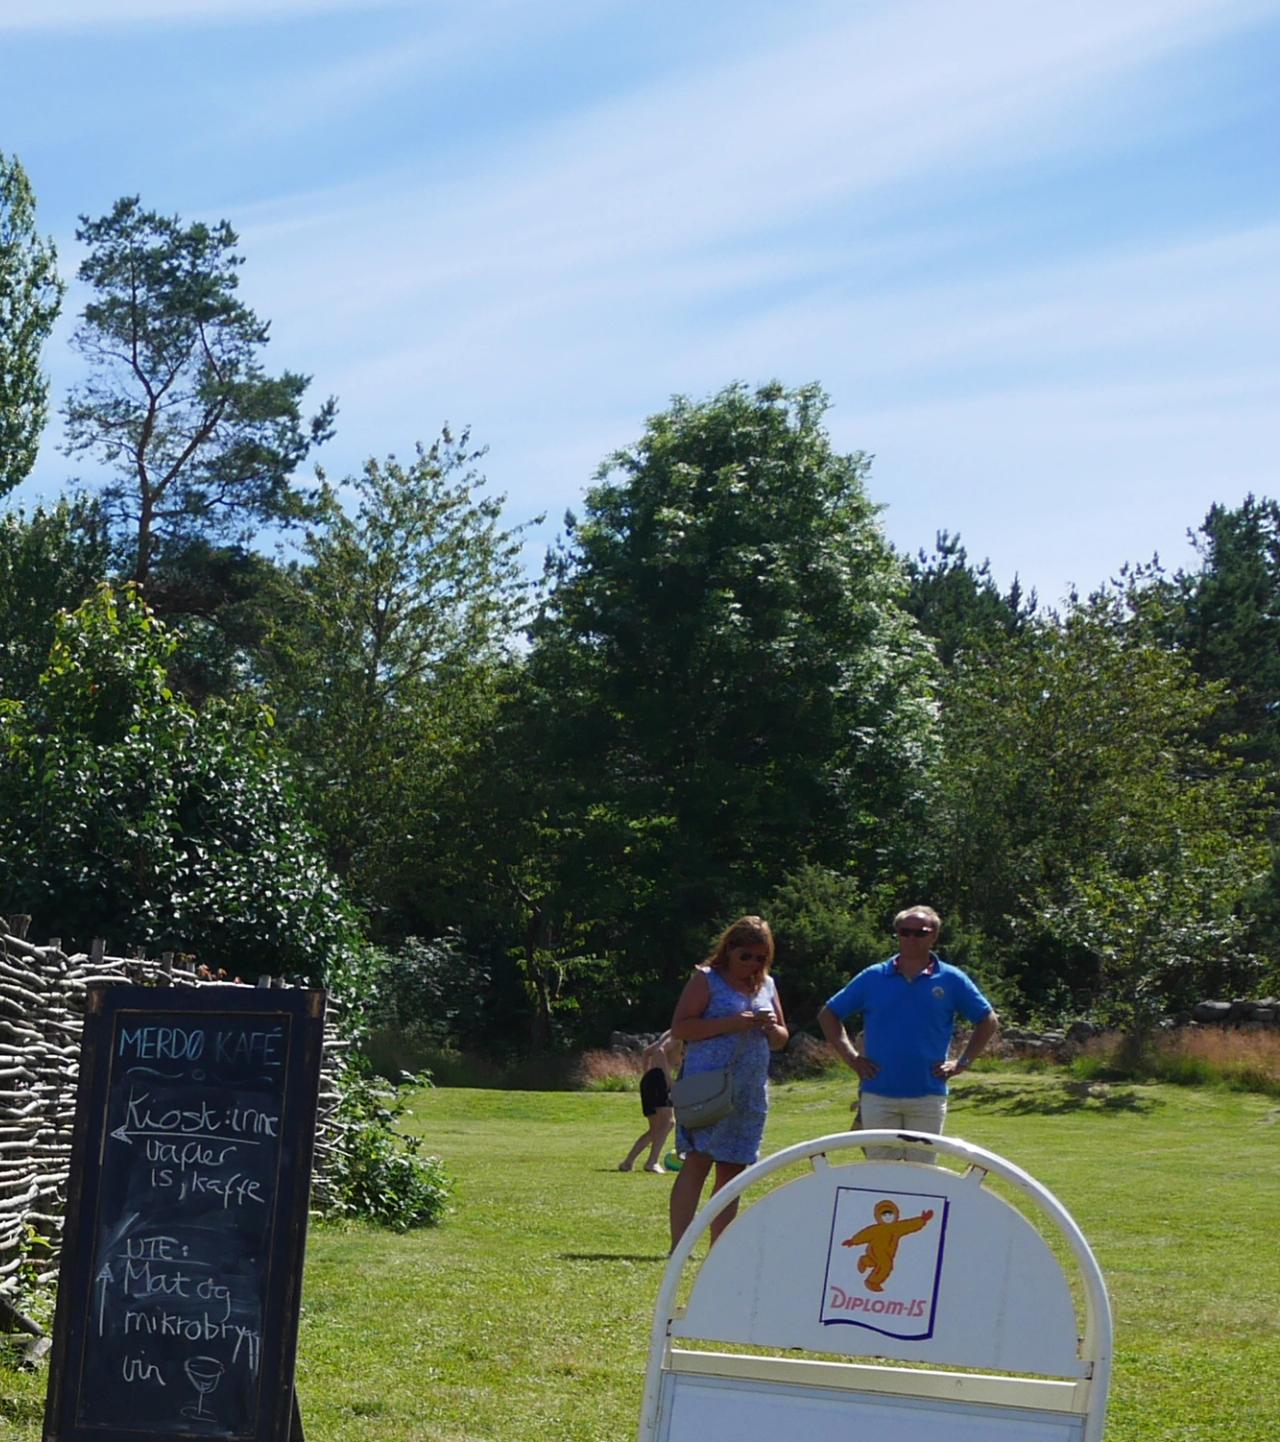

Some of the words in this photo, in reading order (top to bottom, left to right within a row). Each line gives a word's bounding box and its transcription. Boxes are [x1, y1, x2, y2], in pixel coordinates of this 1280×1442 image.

[119, 1028, 204, 1060] MERDØ
[124, 1259, 190, 1297] Mat
[196, 1278, 231, 1323] og
[122, 1351, 167, 1386] vin
